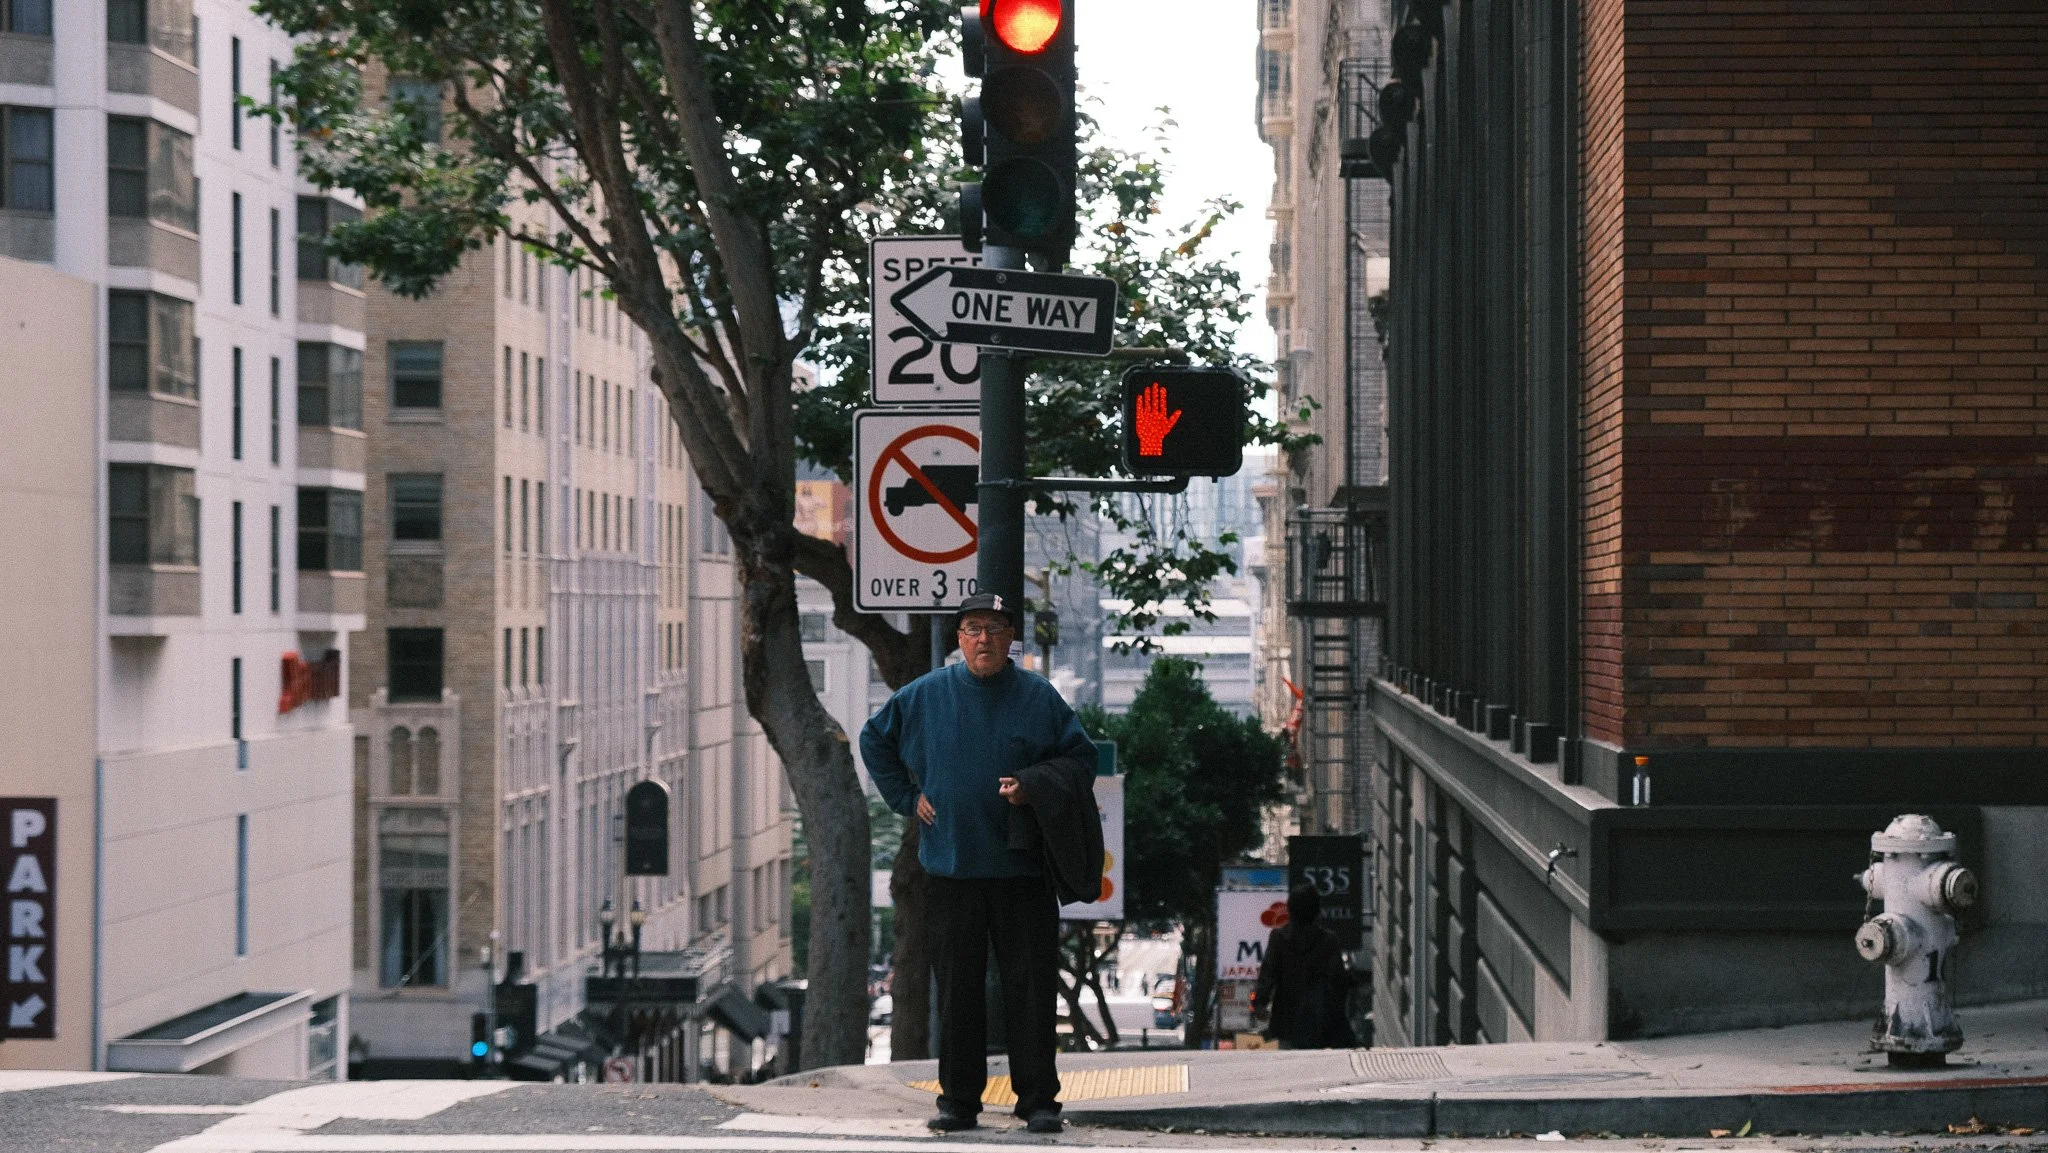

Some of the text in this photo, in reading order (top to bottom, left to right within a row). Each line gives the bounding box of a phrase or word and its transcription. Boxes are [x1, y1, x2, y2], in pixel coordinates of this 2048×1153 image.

[952, 291, 1090, 328] ONE WAY
[888, 326, 981, 385] 20
[871, 578, 919, 597] OVER
[931, 569, 948, 599] 3
[7, 808, 47, 983] PARK
[1304, 867, 1350, 896] 535
[1222, 966, 1261, 977] JAPA
